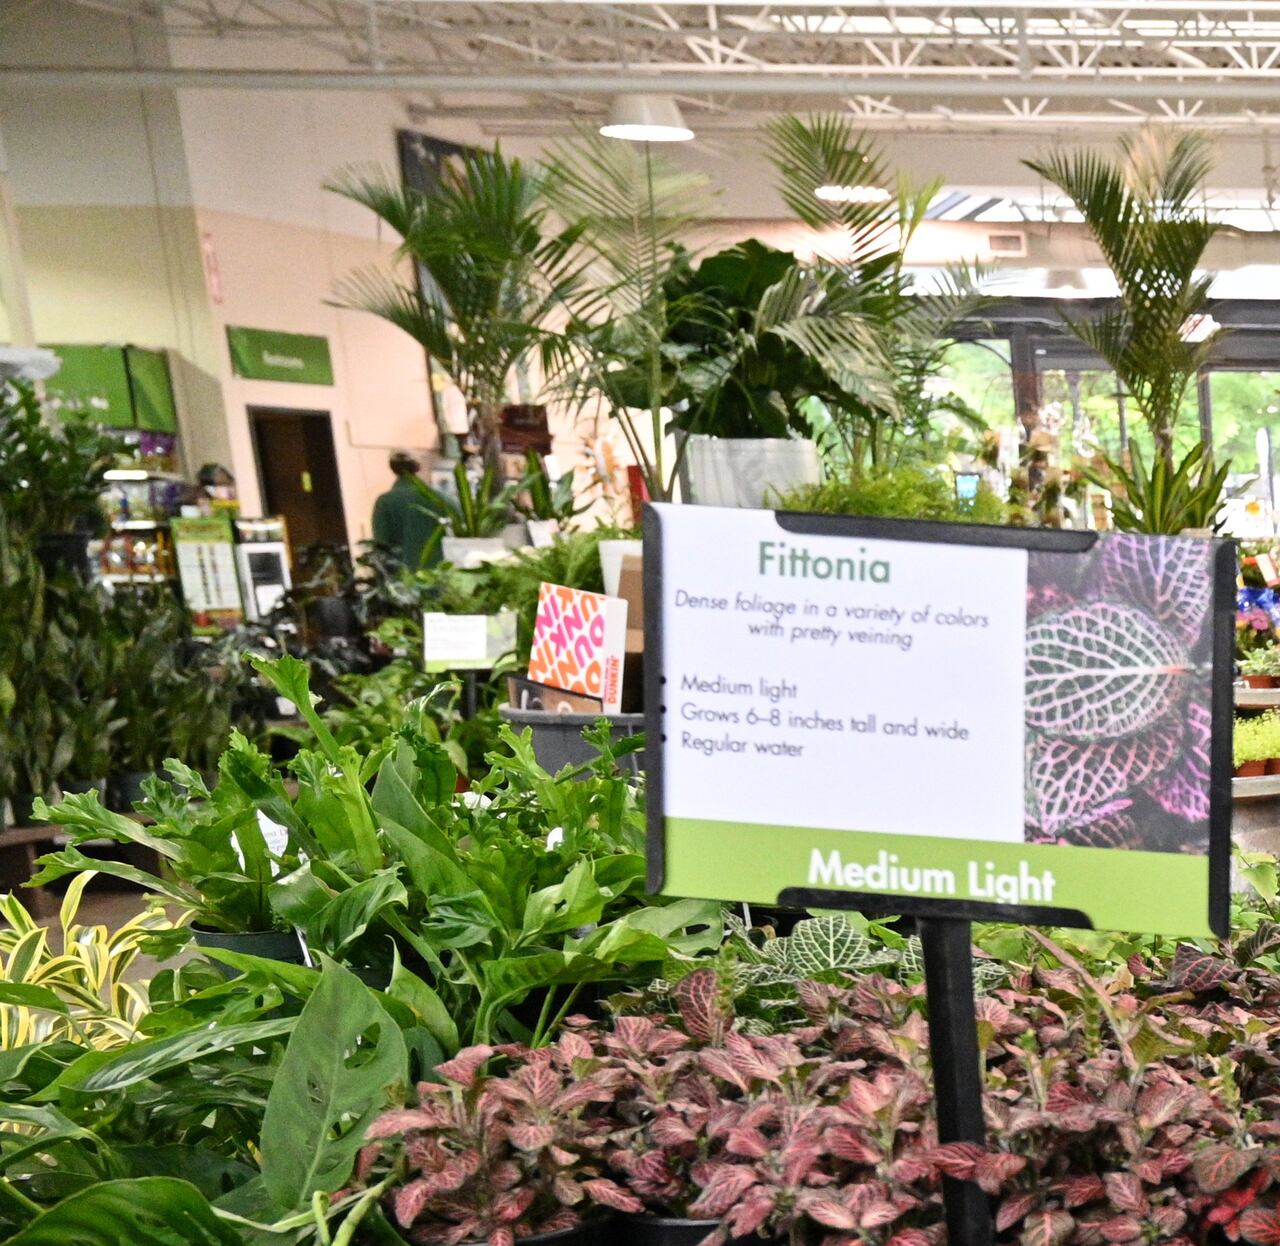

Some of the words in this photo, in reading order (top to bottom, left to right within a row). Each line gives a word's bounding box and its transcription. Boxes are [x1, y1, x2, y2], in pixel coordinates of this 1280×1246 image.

[760, 541, 890, 583] Fittonia
[675, 588, 728, 610] Dense
[735, 591, 796, 620] foliage
[803, 598, 819, 617] in
[826, 605, 837, 618] a
[846, 603, 904, 626] variety
[911, 604, 932, 624] of
[935, 606, 989, 628] colors
[748, 620, 785, 638] with
[790, 625, 840, 646] pretty
[849, 627, 913, 651] veining
[681, 674, 752, 695] Medium
[760, 677, 797, 703] light
[681, 702, 740, 724] Grows
[788, 710, 844, 731] inches
[851, 714, 876, 734] tall
[883, 718, 918, 737] and
[924, 720, 970, 741] wide
[682, 731, 747, 756] Regular
[754, 742, 804, 757] water
[808, 848, 956, 894] Medium
[968, 860, 1056, 904] Light
